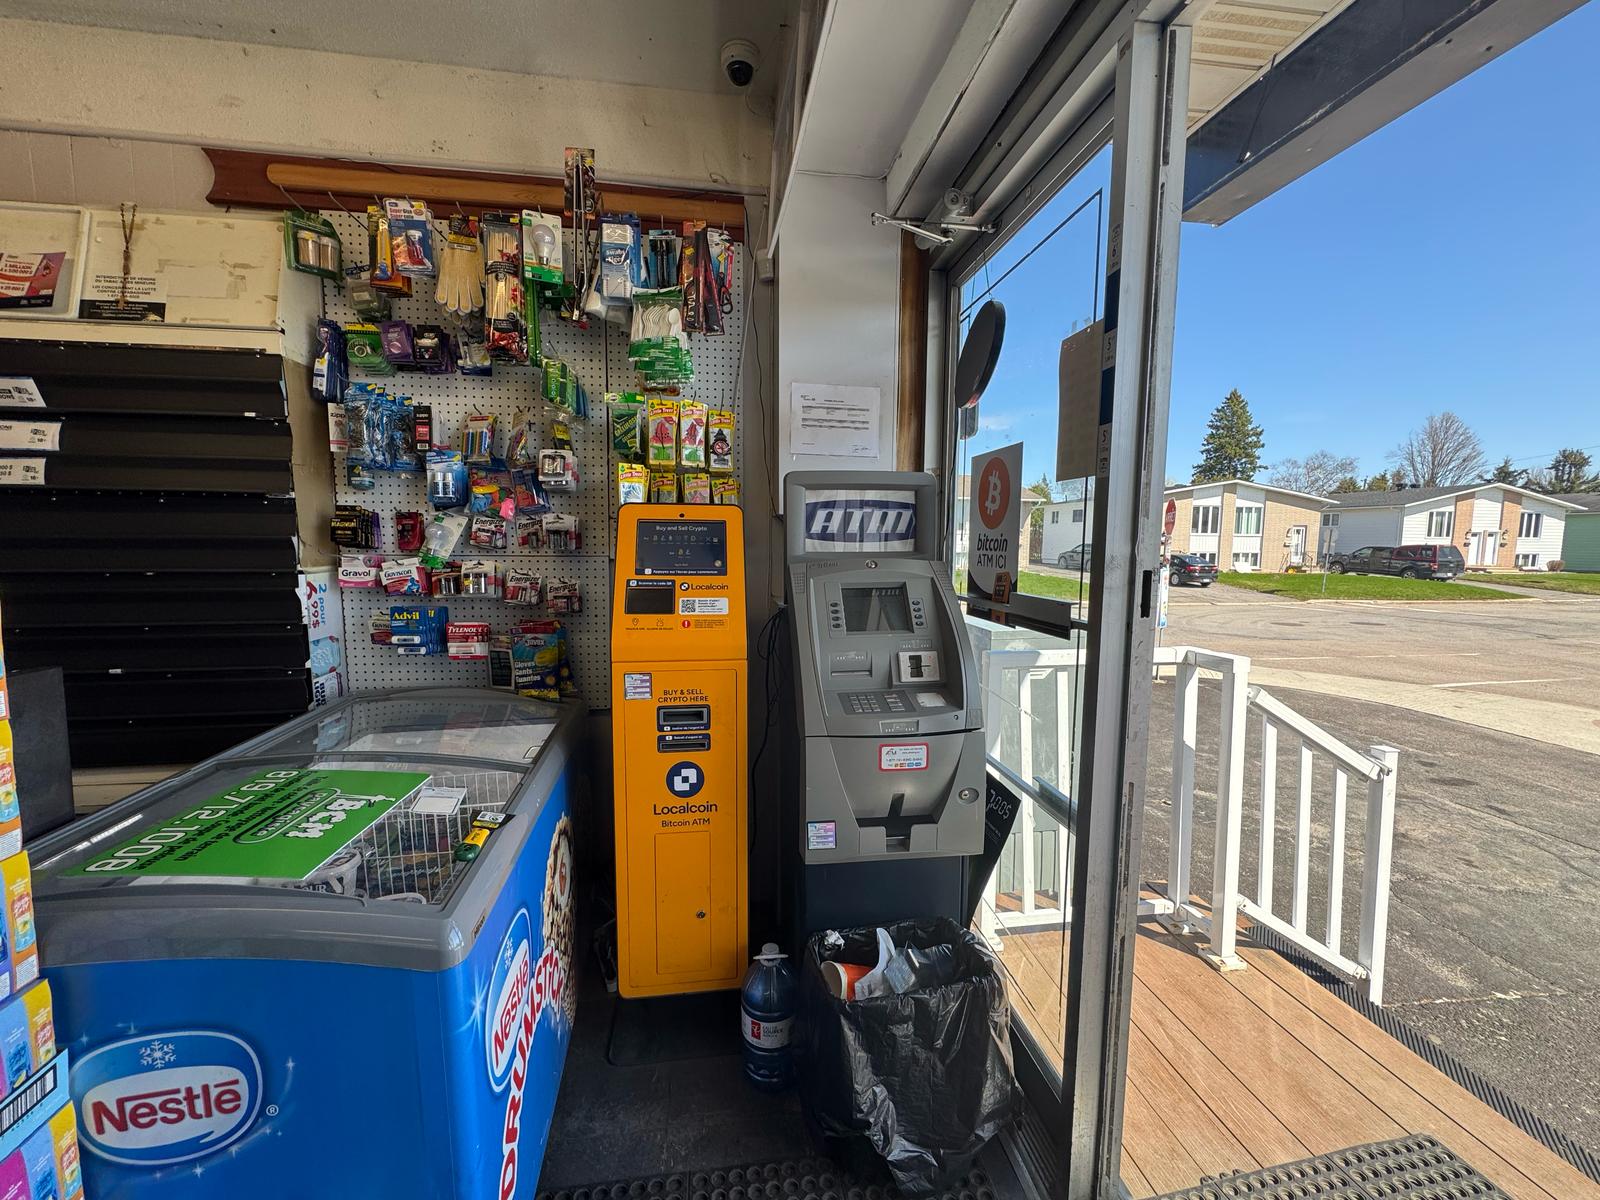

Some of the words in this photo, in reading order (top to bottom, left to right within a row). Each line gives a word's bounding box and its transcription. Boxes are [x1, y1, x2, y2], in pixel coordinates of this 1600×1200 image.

[474, 517, 505, 526] Energizer
[809, 507, 914, 534] ATM
[976, 533, 1008, 552] bitcoin
[976, 553, 994, 568] ATM
[995, 554, 1007, 569] ICI
[341, 569, 371, 577] Gravol
[384, 569, 412, 578] Gaviscon
[509, 575, 541, 583] Energizer
[318, 583, 327, 593] 2
[548, 582, 578, 593] Energizer
[691, 583, 729, 591] Localcoin
[318, 597, 326, 625] pour
[392, 610, 420, 620] Advil
[447, 626, 478, 634] TYLENOL
[516, 675, 541, 683] Guantes
[313, 681, 321, 708] LIGH
[319, 682, 327, 706] BUD
[658, 696, 689, 704] CRYPTO
[256, 792, 328, 837] paysagiste
[653, 801, 718, 816] Localcoin
[77, 769, 301, 872] 819.712.1008
[220, 806, 276, 832] Nettoyage
[280, 798, 369, 839] BCM
[661, 819, 690, 828] Bitcoin
[691, 818, 711, 826] ATM
[173, 839, 221, 861] terrain
[493, 951, 530, 1070] Nestlé
[499, 946, 565, 1200] DRUMSTICK
[91, 1078, 242, 1135] Nestlé
